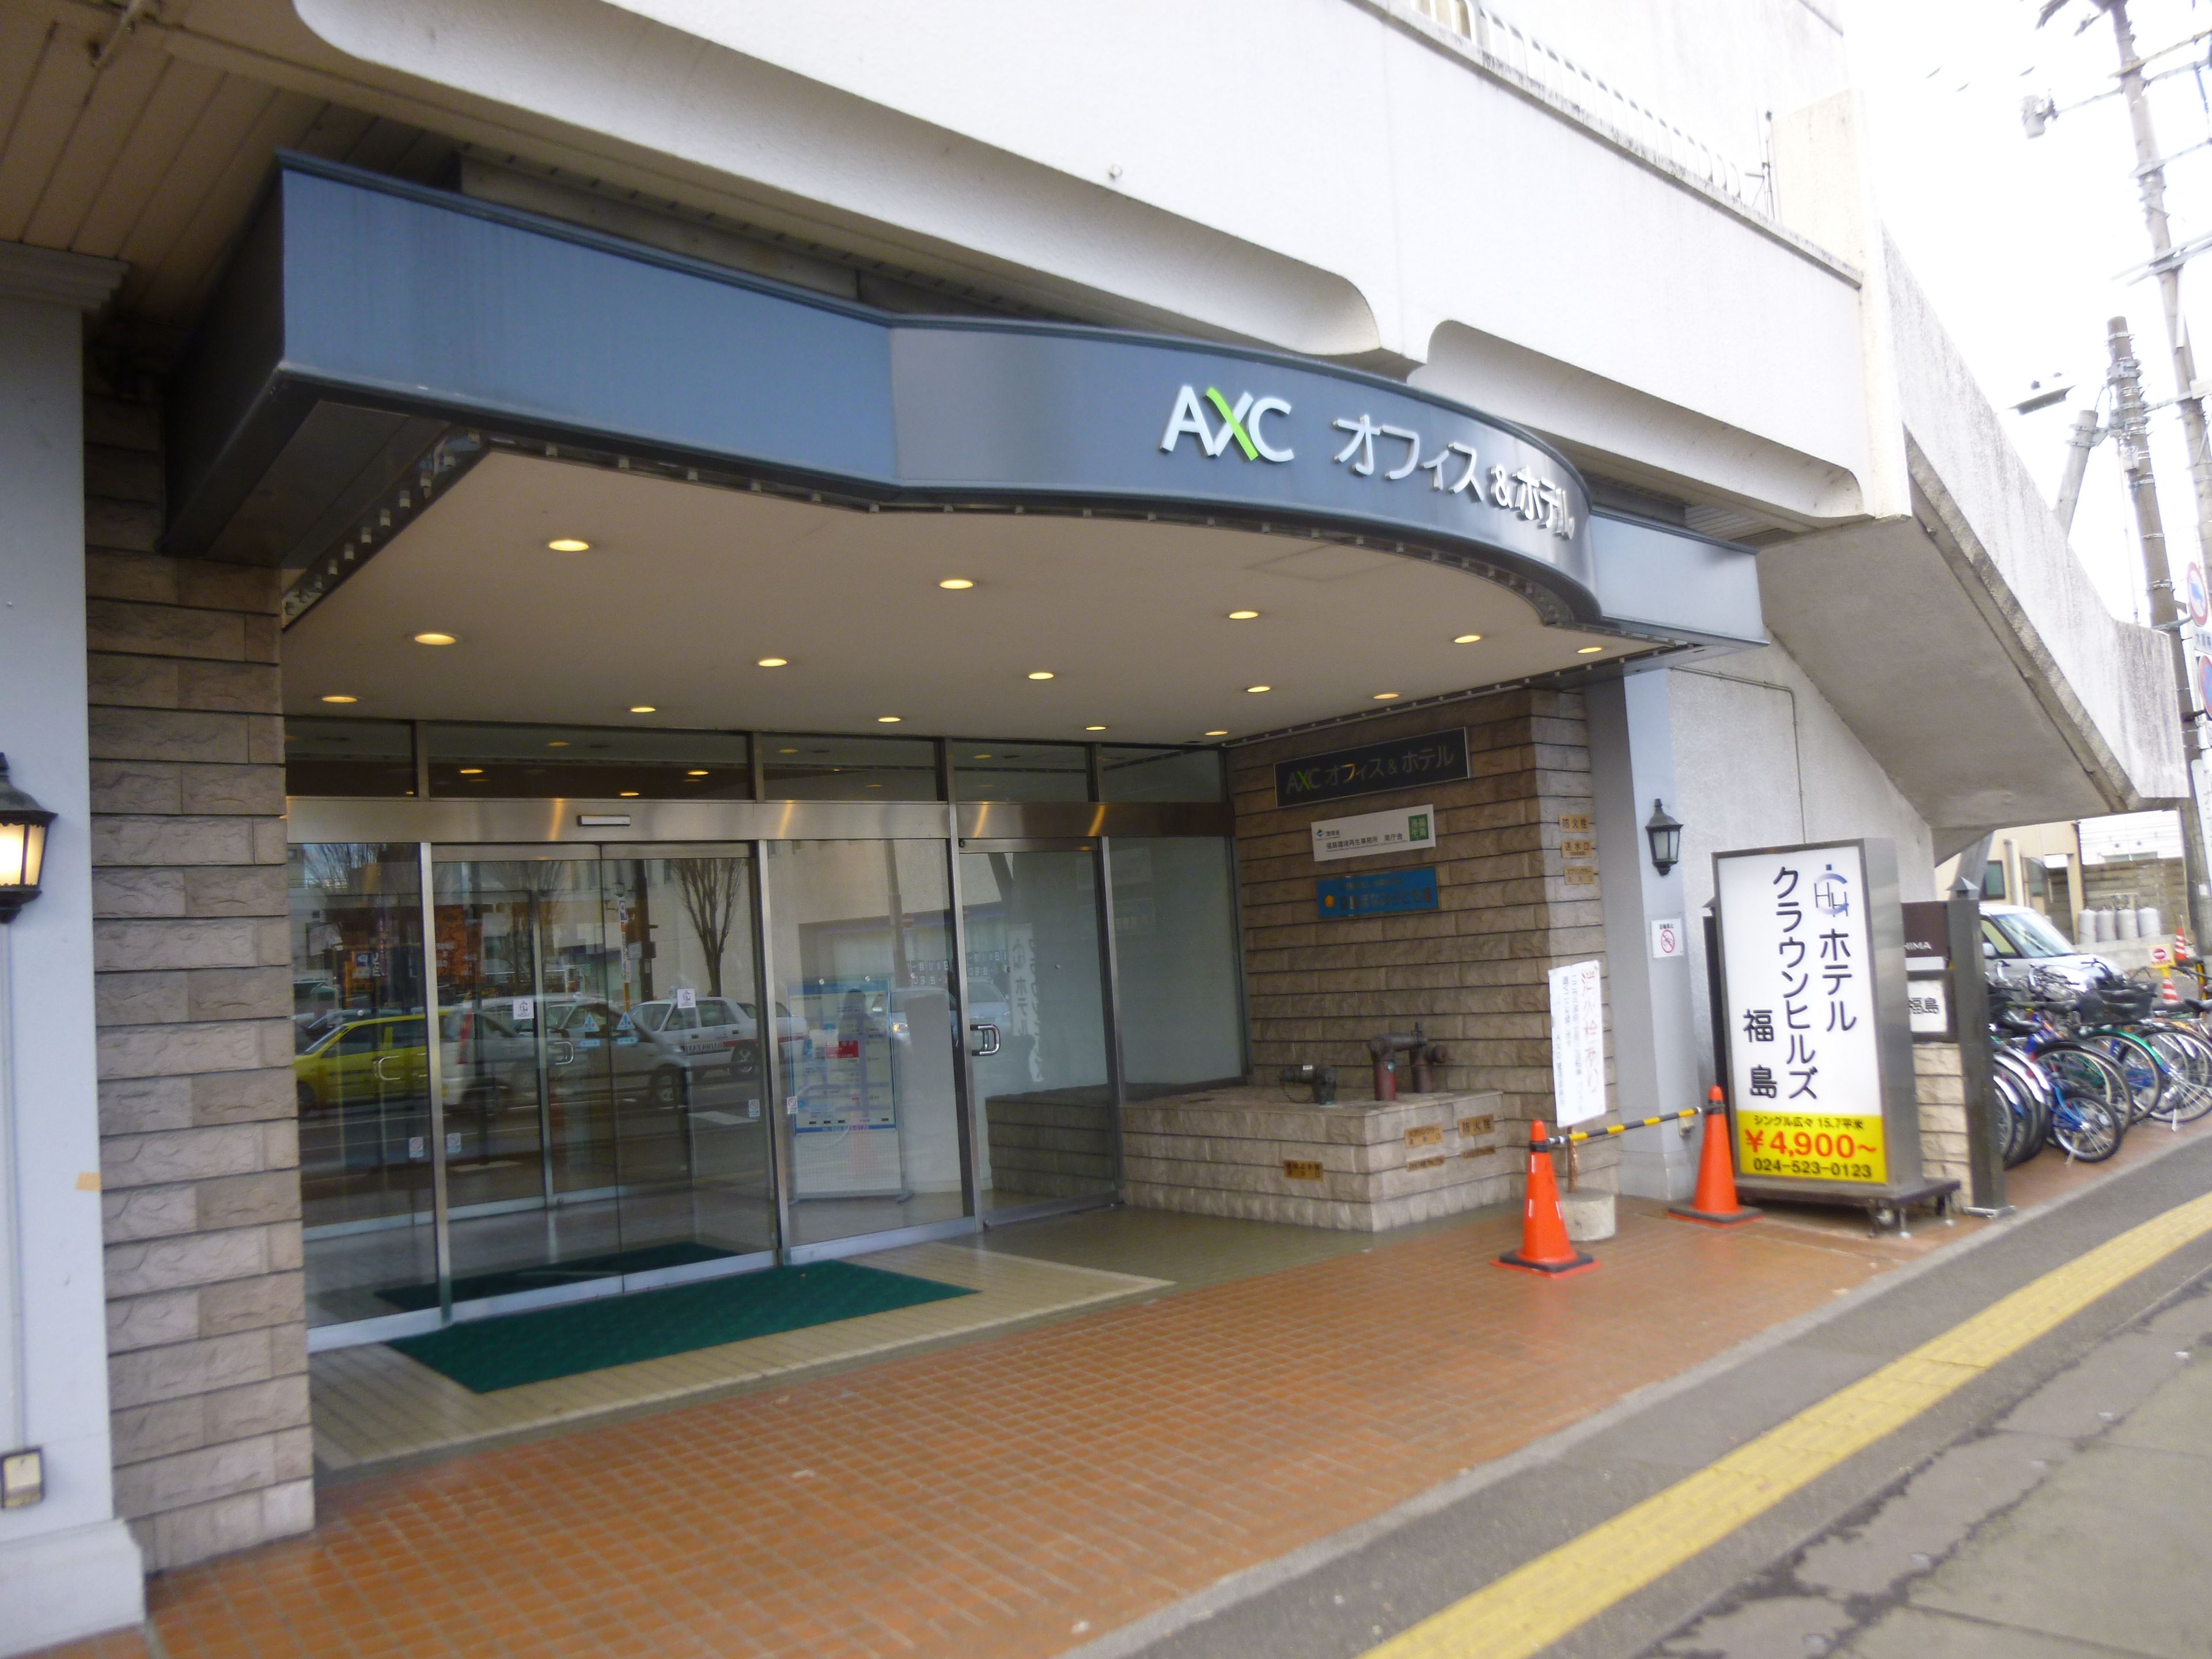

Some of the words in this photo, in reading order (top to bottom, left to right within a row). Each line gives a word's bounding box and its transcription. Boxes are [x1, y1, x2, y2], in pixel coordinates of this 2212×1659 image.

[1160, 385, 1294, 463] AXC
[1772, 866, 1819, 1100] クラウンヒルズ
[1819, 928, 1857, 1032] ホテル
[1753, 1115, 1814, 1128] シングル広々
[1818, 1118, 1865, 1130] 15.7平米
[1753, 1157, 1872, 1178] 024-523-0123
